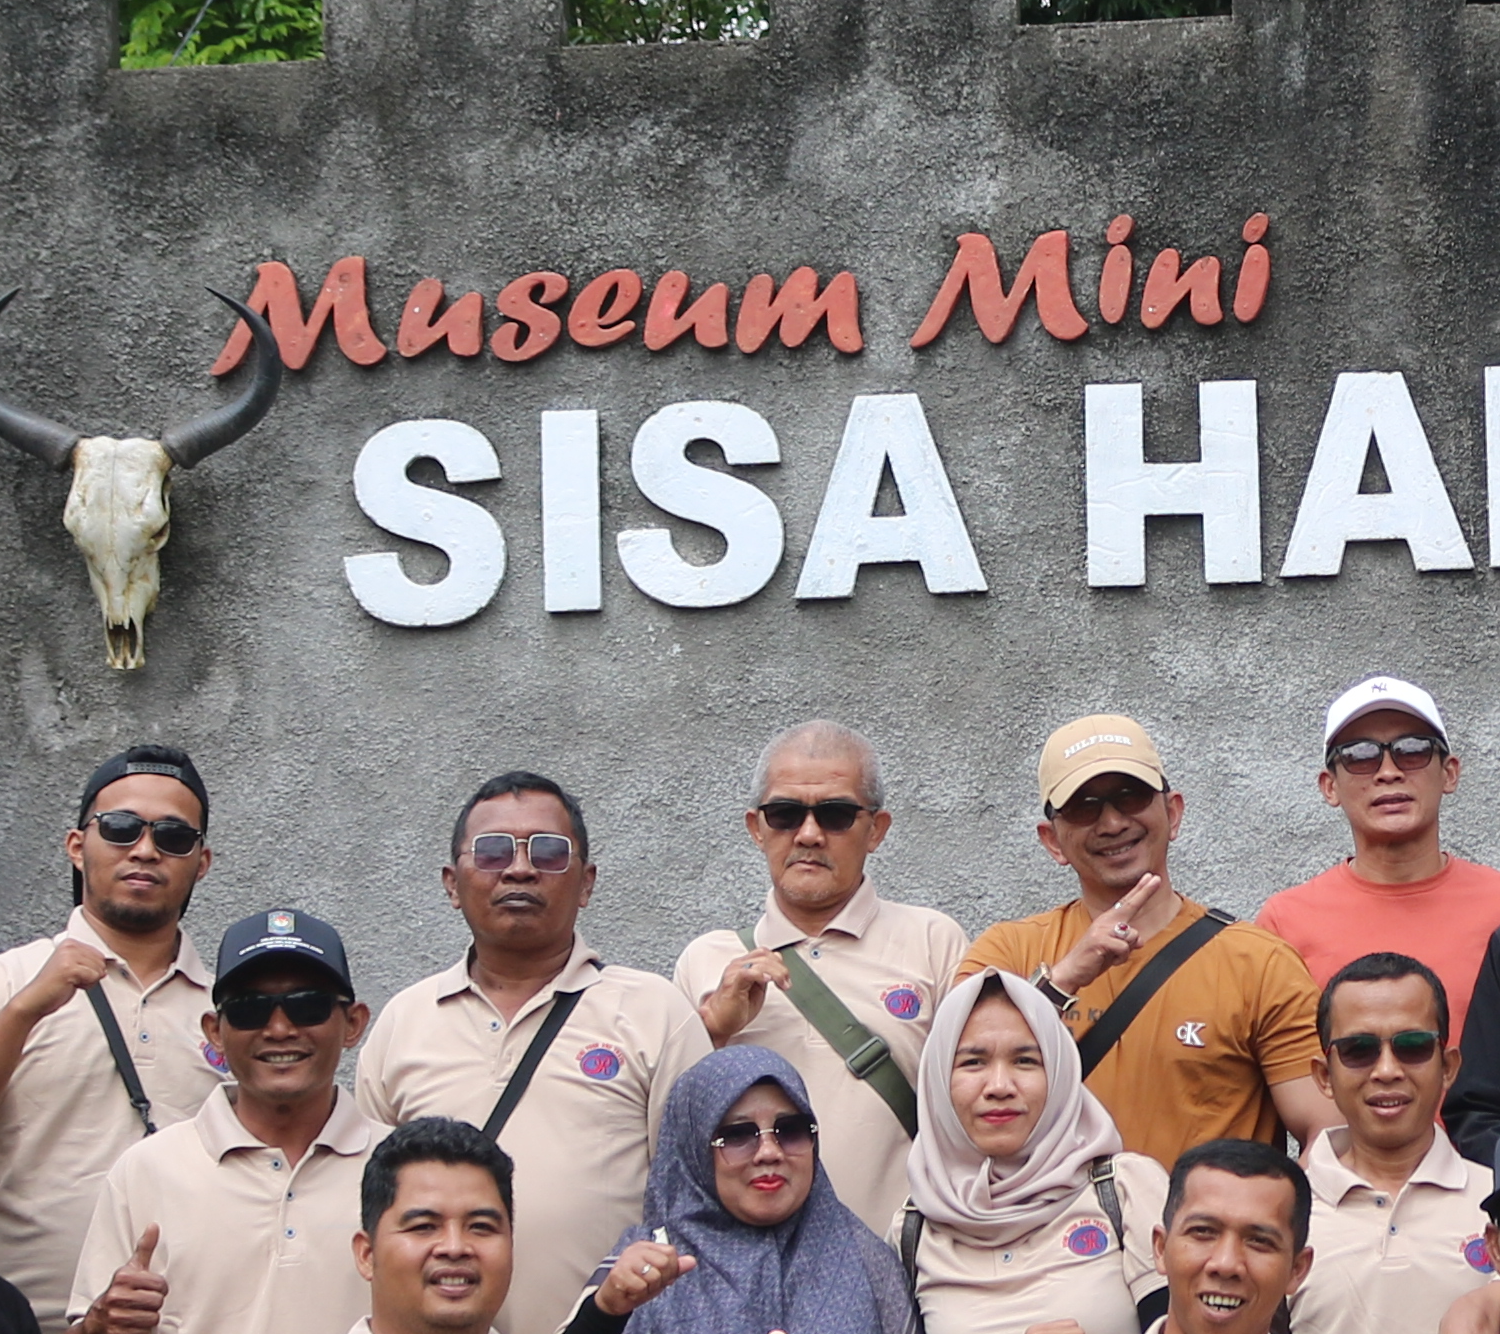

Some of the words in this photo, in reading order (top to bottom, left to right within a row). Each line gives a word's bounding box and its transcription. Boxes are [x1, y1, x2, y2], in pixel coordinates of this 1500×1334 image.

[210, 256, 864, 375] Museum
[910, 213, 1271, 347] Mini
[343, 393, 988, 625] SISA
[1063, 733, 1132, 760] HILFIGER
